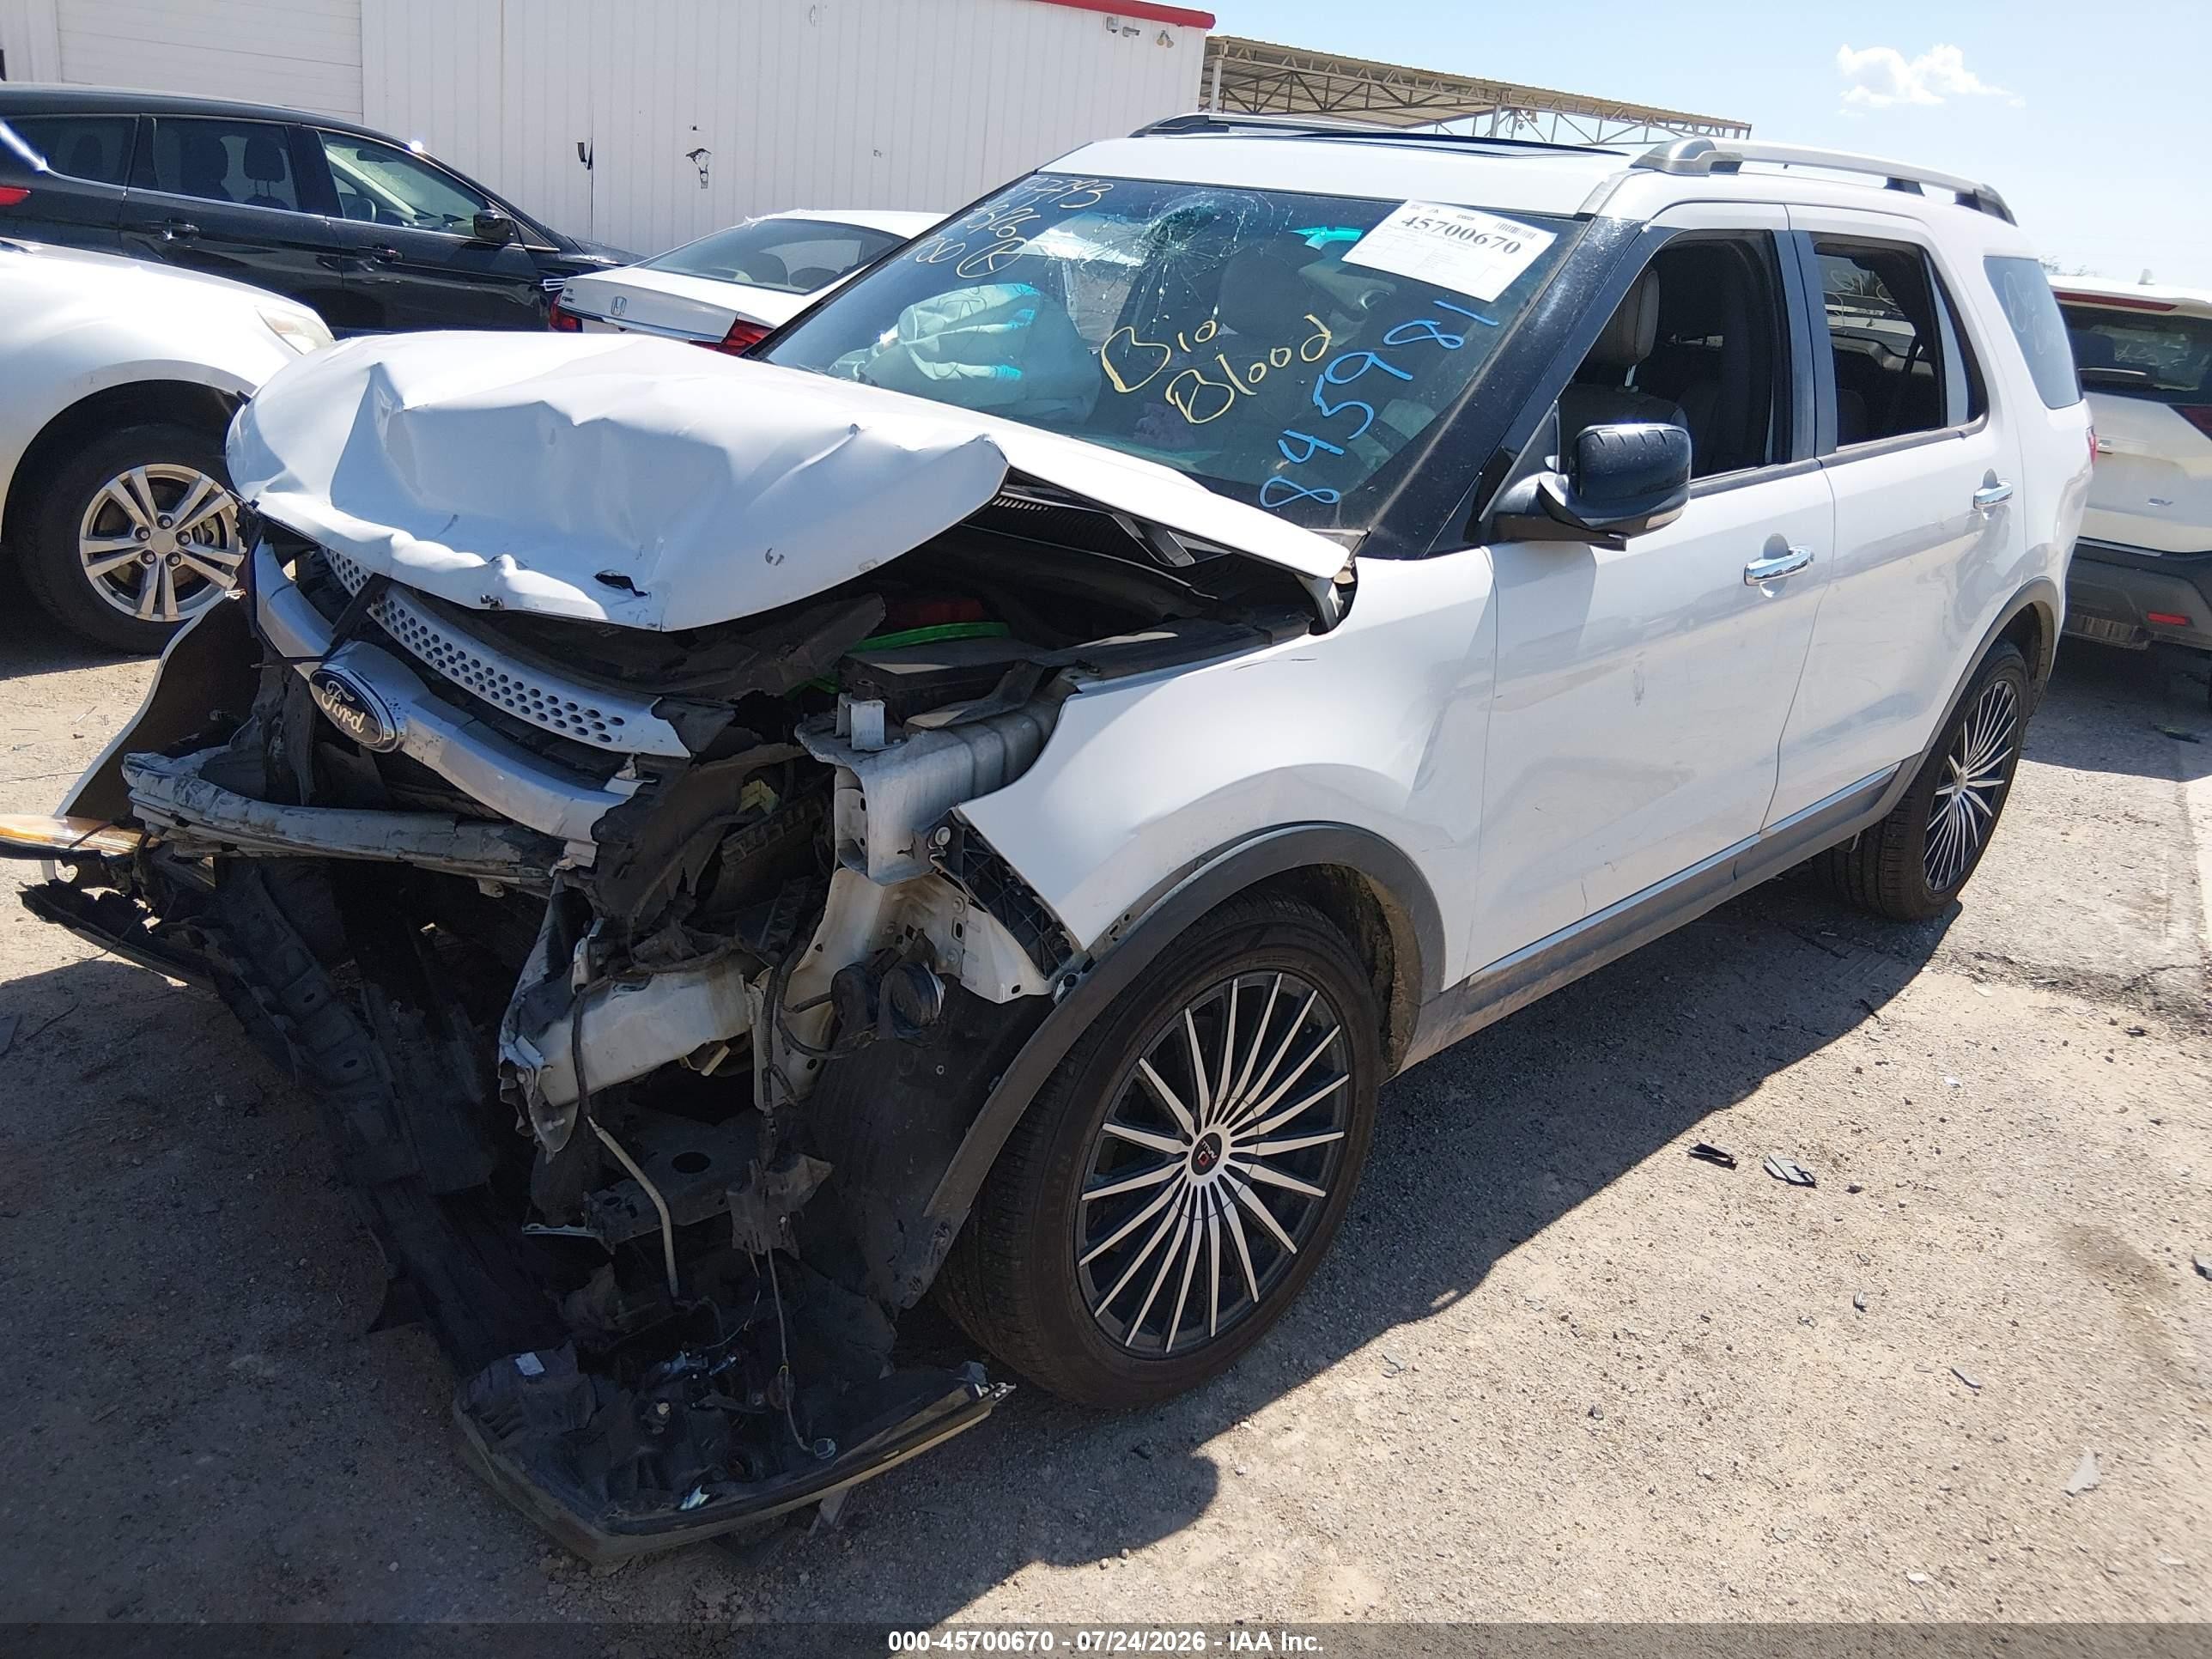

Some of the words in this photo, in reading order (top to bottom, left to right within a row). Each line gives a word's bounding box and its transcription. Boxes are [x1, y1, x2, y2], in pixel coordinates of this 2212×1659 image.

[1401, 215, 1522, 255] 45700670
[1102, 319, 1216, 393] Bio
[1165, 313, 1332, 424] Blood
[1259, 300, 1499, 508] 845981
[320, 679, 366, 734] Ford
